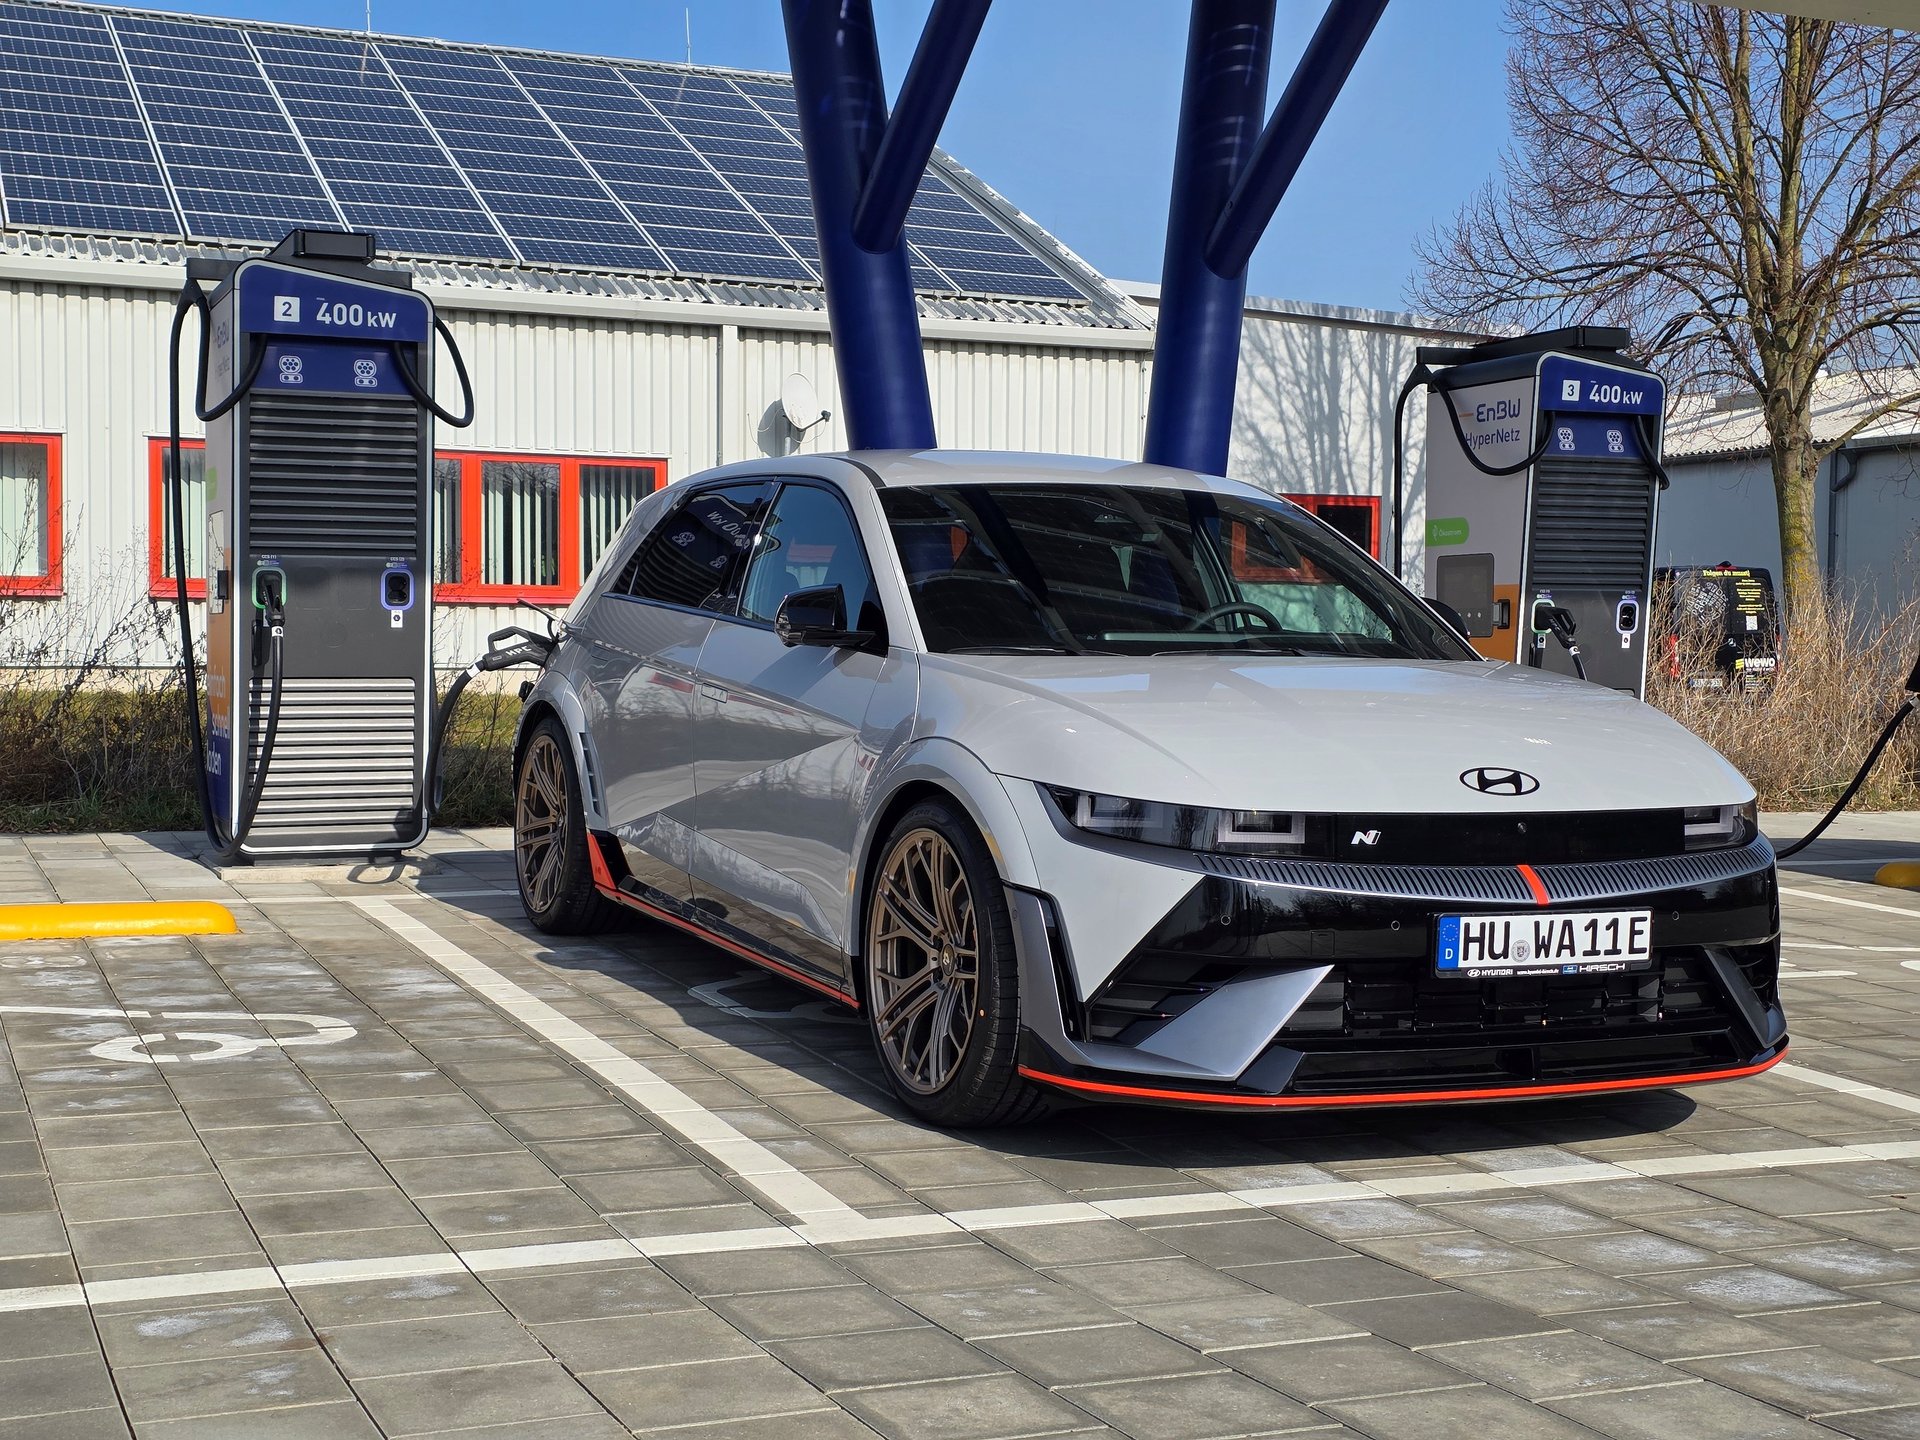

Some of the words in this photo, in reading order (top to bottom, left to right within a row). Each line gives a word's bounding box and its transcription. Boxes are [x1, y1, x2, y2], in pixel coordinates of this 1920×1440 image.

[281, 301, 292, 317] 2
[316, 302, 363, 326] 400
[367, 311, 397, 328] kW
[1567, 384, 1575, 397] 3
[1589, 385, 1621, 404] 400
[1622, 391, 1643, 405] kW
[1476, 398, 1521, 423] EnBW
[1465, 427, 1520, 450] HyperNetz
[1462, 921, 1510, 961] HU
[1445, 948, 1453, 960] D
[1481, 968, 1513, 976] HYUNDAI
[1580, 963, 1625, 972] HIRSCH
